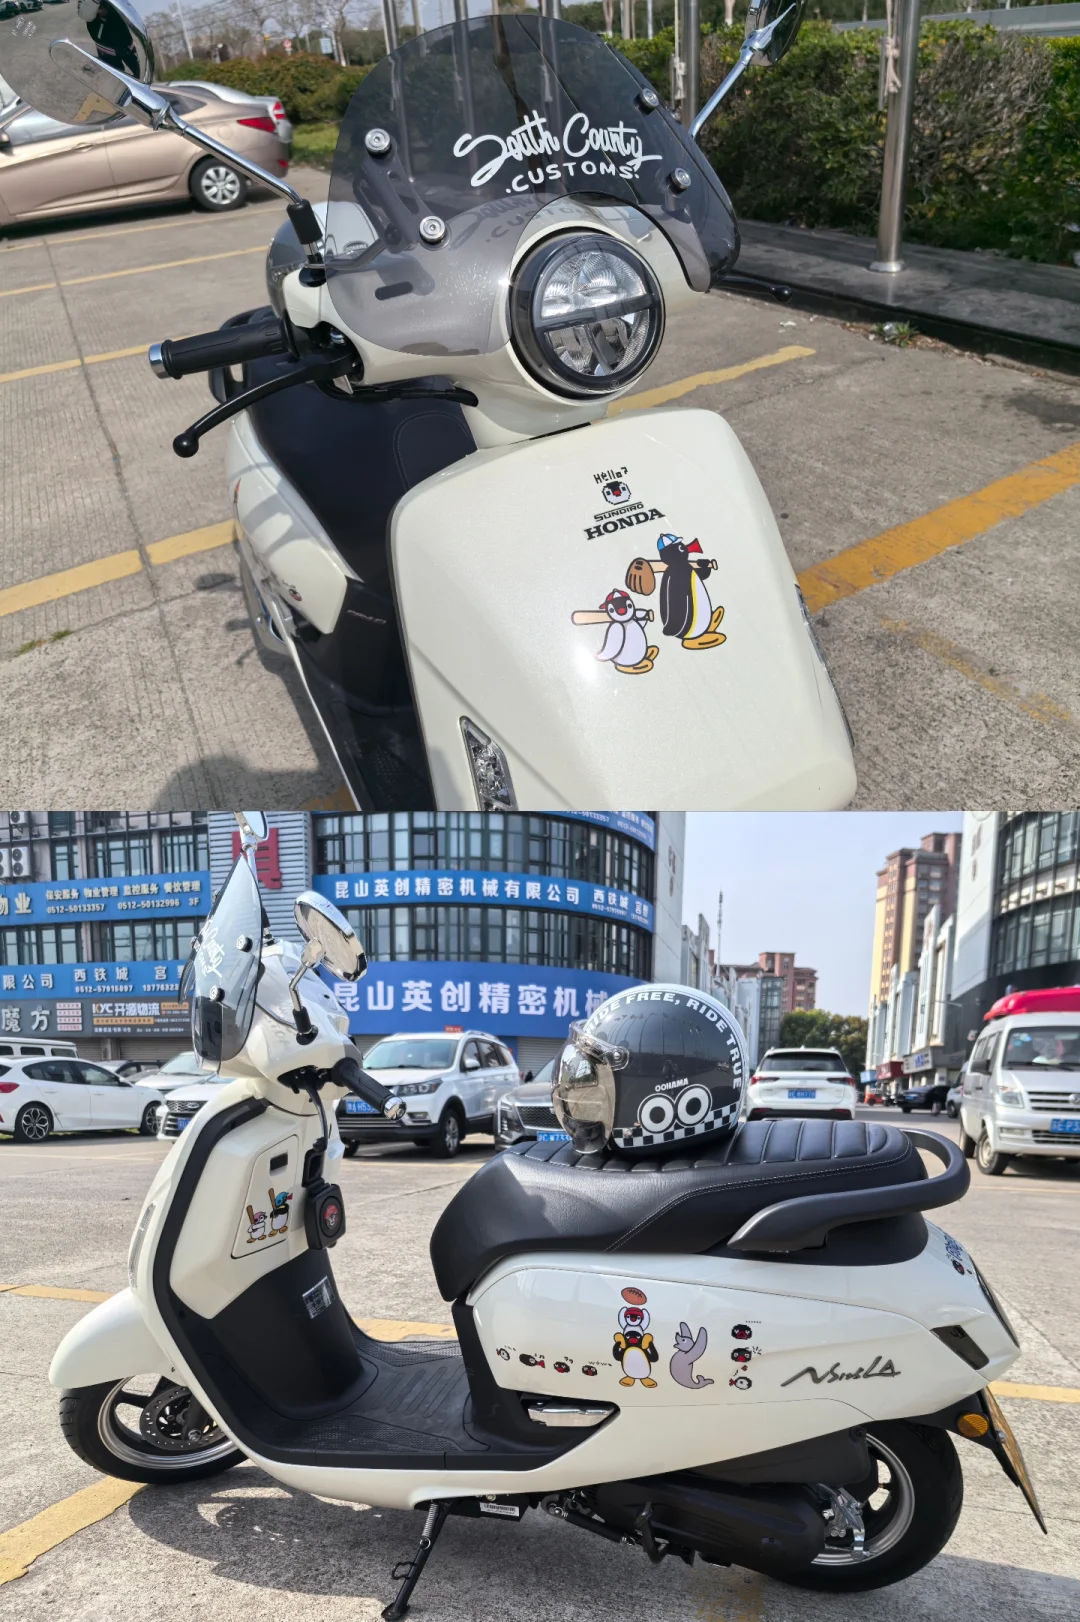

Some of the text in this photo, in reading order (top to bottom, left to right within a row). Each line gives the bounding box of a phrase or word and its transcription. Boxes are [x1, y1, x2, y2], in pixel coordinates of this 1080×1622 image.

[453, 110, 662, 187] South County
[593, 466, 628, 485] Hello?
[584, 508, 666, 541] HONDA
[594, 502, 644, 522] SUNDIRO
[188, 897, 200, 907] 3F
[334, 877, 580, 906] 昆山英创精密机械有限公司
[3, 973, 54, 990] 限公司
[73, 967, 130, 983] 西铁城
[334, 980, 612, 1019] 昆山英创精密机械
[1, 1007, 52, 1033] 魔方
[626, 991, 681, 1005] FREE,
[686, 998, 730, 1033] RIDE
[726, 1033, 743, 1089] TRUE
